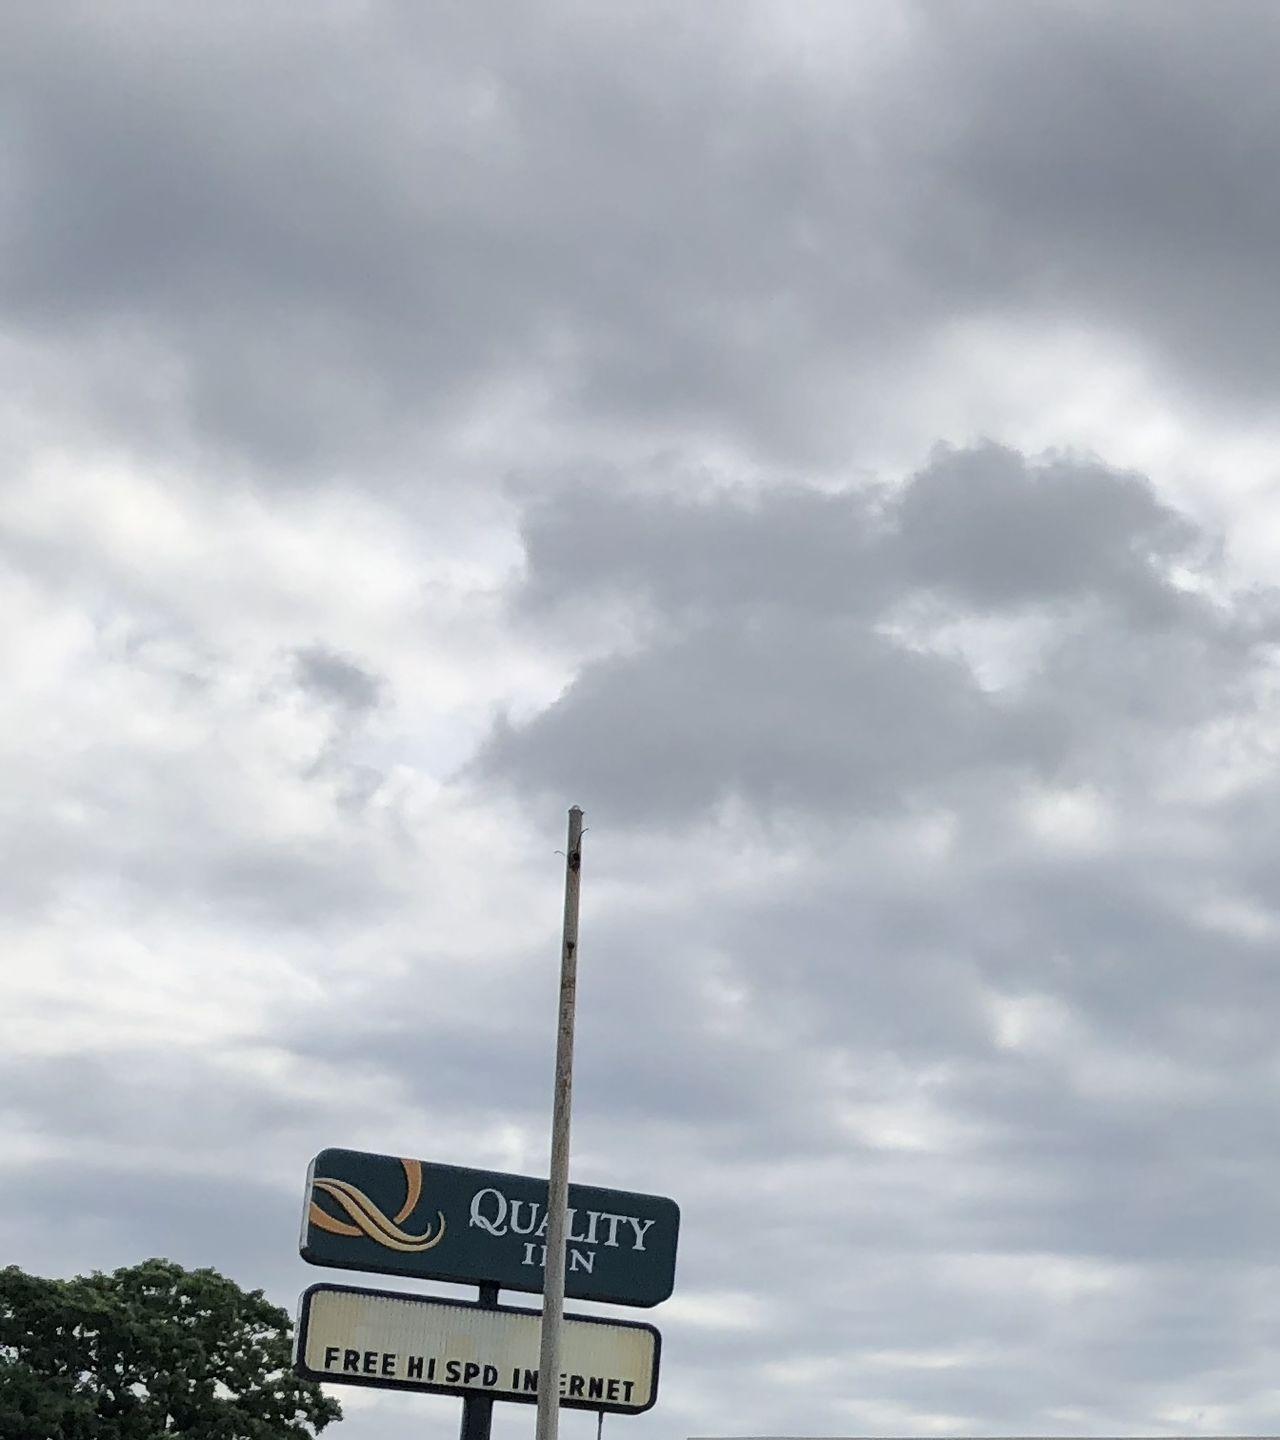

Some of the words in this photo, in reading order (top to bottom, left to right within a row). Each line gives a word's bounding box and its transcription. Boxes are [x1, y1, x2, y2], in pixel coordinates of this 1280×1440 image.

[521, 1242, 596, 1273] IN
[324, 1346, 396, 1376] FREE
[407, 1355, 436, 1380] HI
[445, 1360, 498, 1386] SPD
[512, 1367, 634, 1402] INERNET
